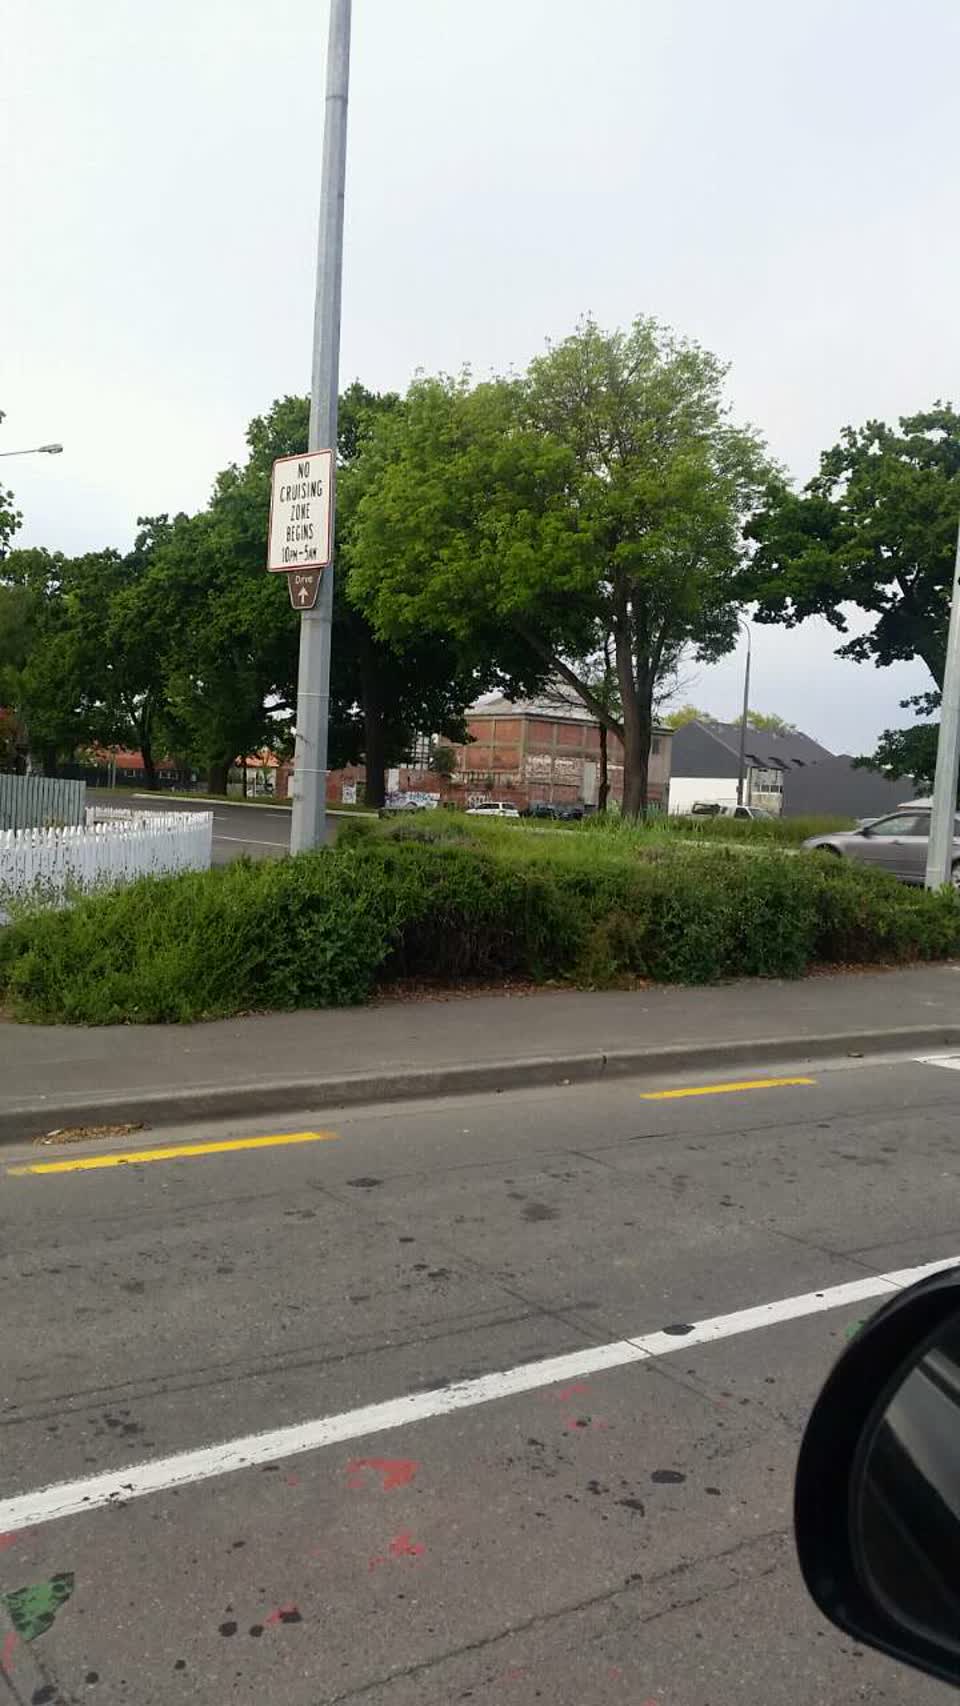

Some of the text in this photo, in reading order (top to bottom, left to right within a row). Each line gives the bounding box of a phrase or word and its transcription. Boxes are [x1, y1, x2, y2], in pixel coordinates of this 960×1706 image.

[298, 461, 310, 479] NO
[280, 480, 323, 503] CRUISING
[290, 502, 310, 522] ZONE
[286, 523, 314, 542] BEGINS
[295, 575, 313, 585] Drive
